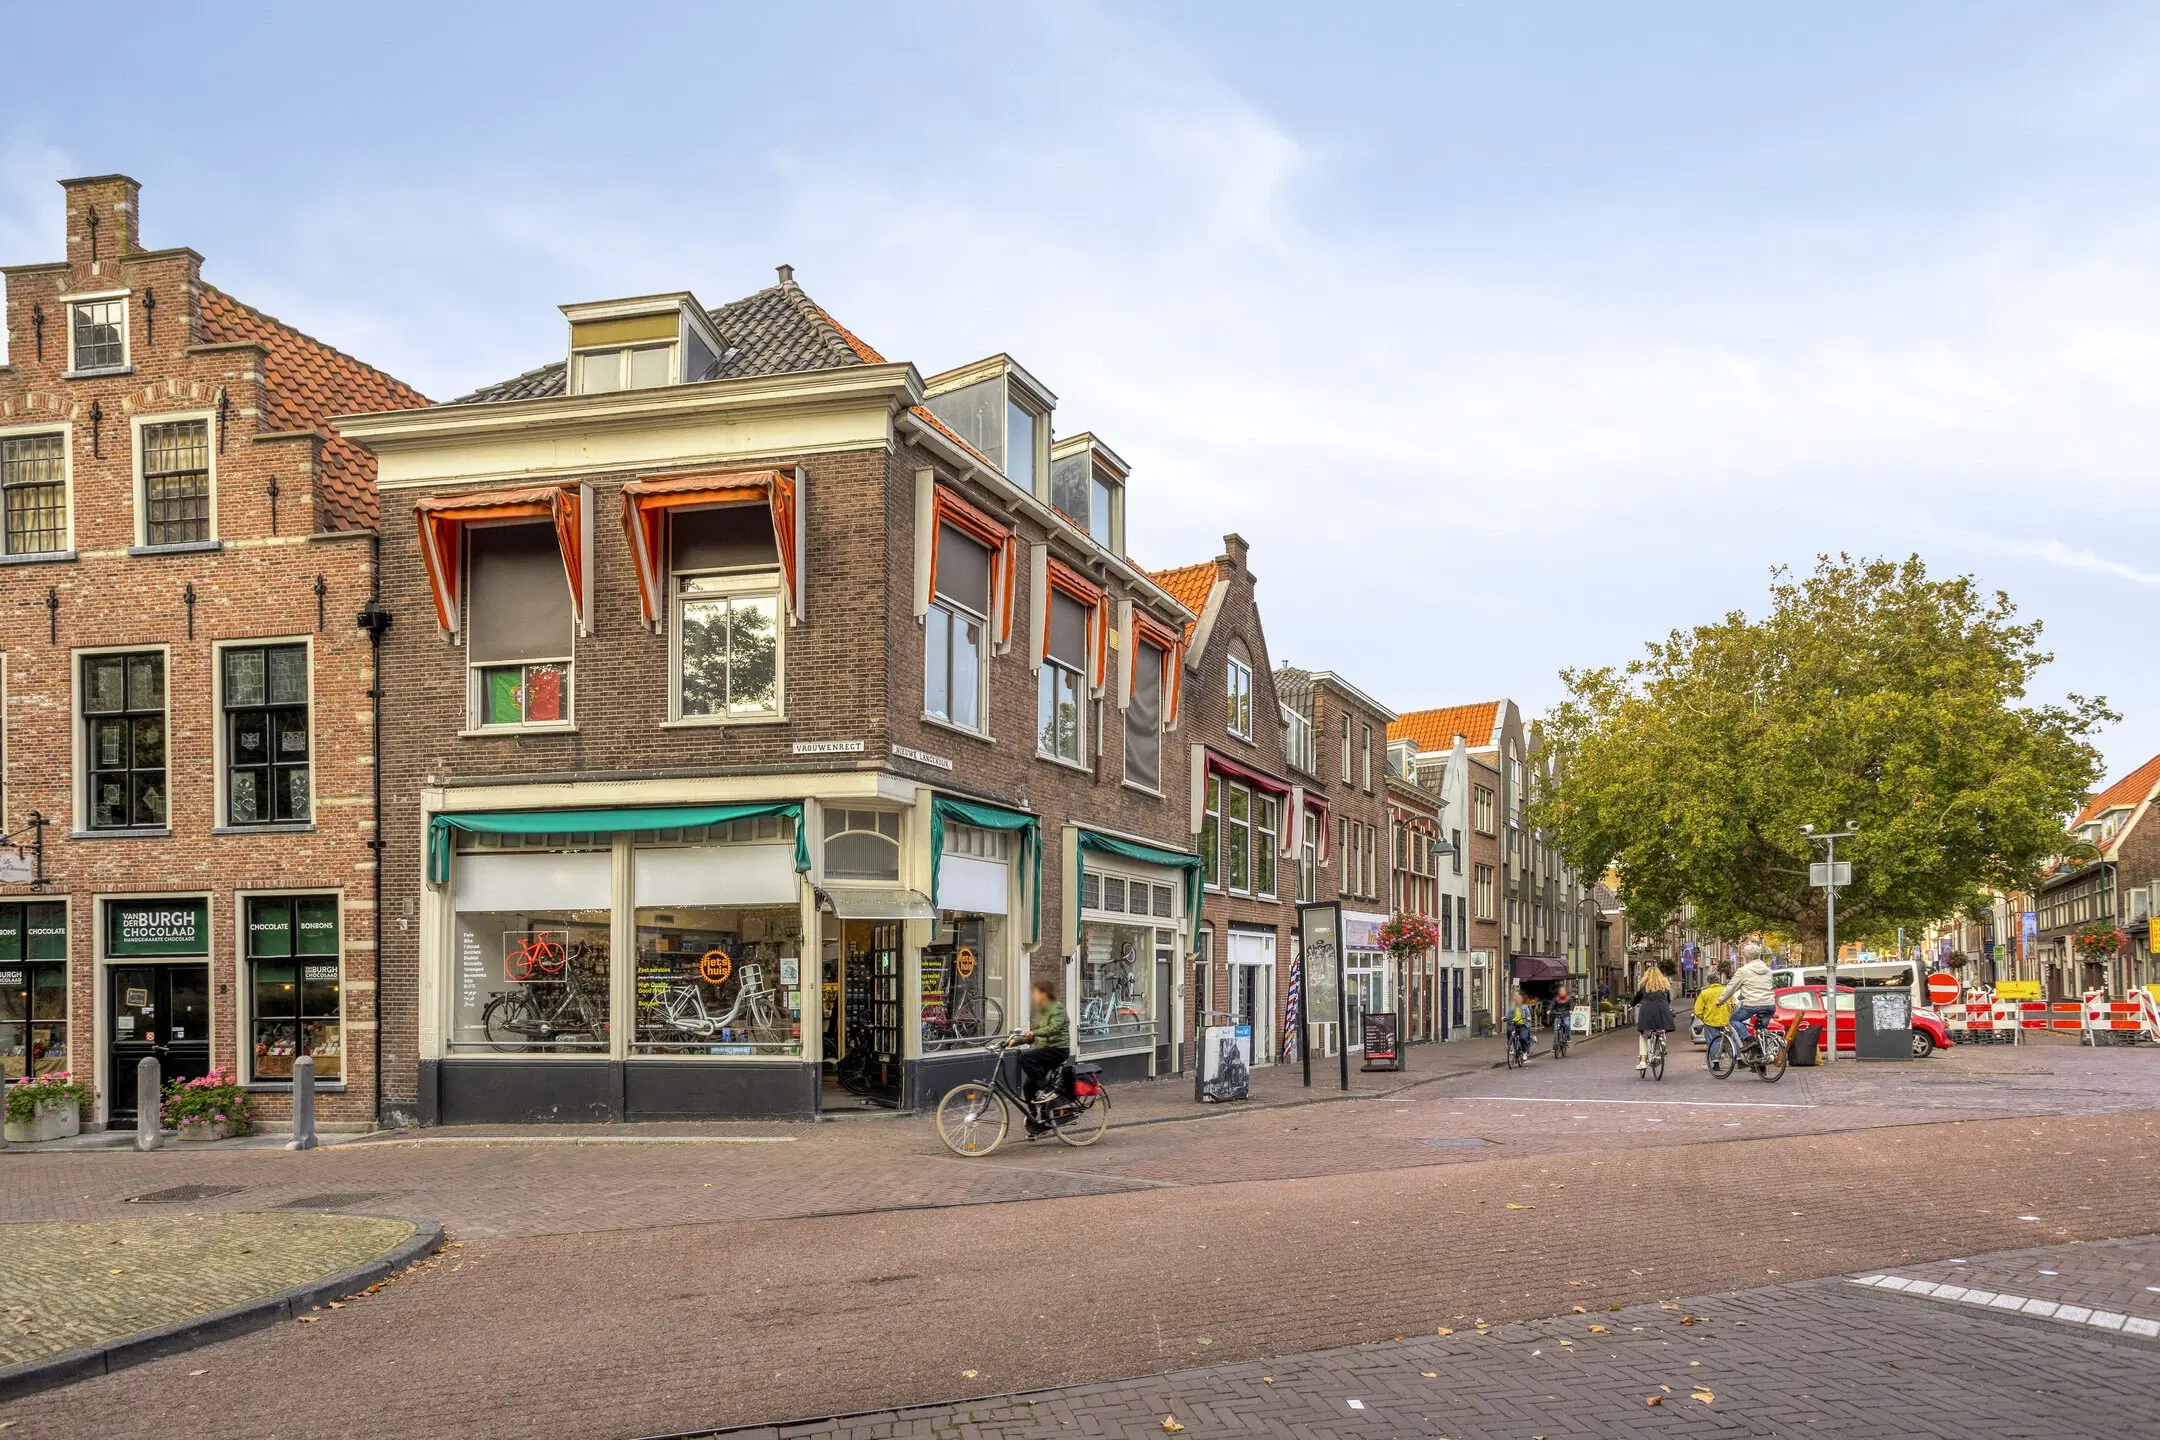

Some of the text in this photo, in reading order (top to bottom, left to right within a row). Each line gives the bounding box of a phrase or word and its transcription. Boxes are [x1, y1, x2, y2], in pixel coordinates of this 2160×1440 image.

[796, 742, 862, 752] VROUWENREGT
[122, 911, 195, 927] VAN BURGH
[123, 919, 139, 927] DER
[250, 923, 289, 931] CHOCOLATE
[300, 922, 333, 930] BONBONS
[123, 927, 195, 937] CHOCOLAAD
[706, 966, 728, 976] huis
[220, 984, 227, 994] 2
